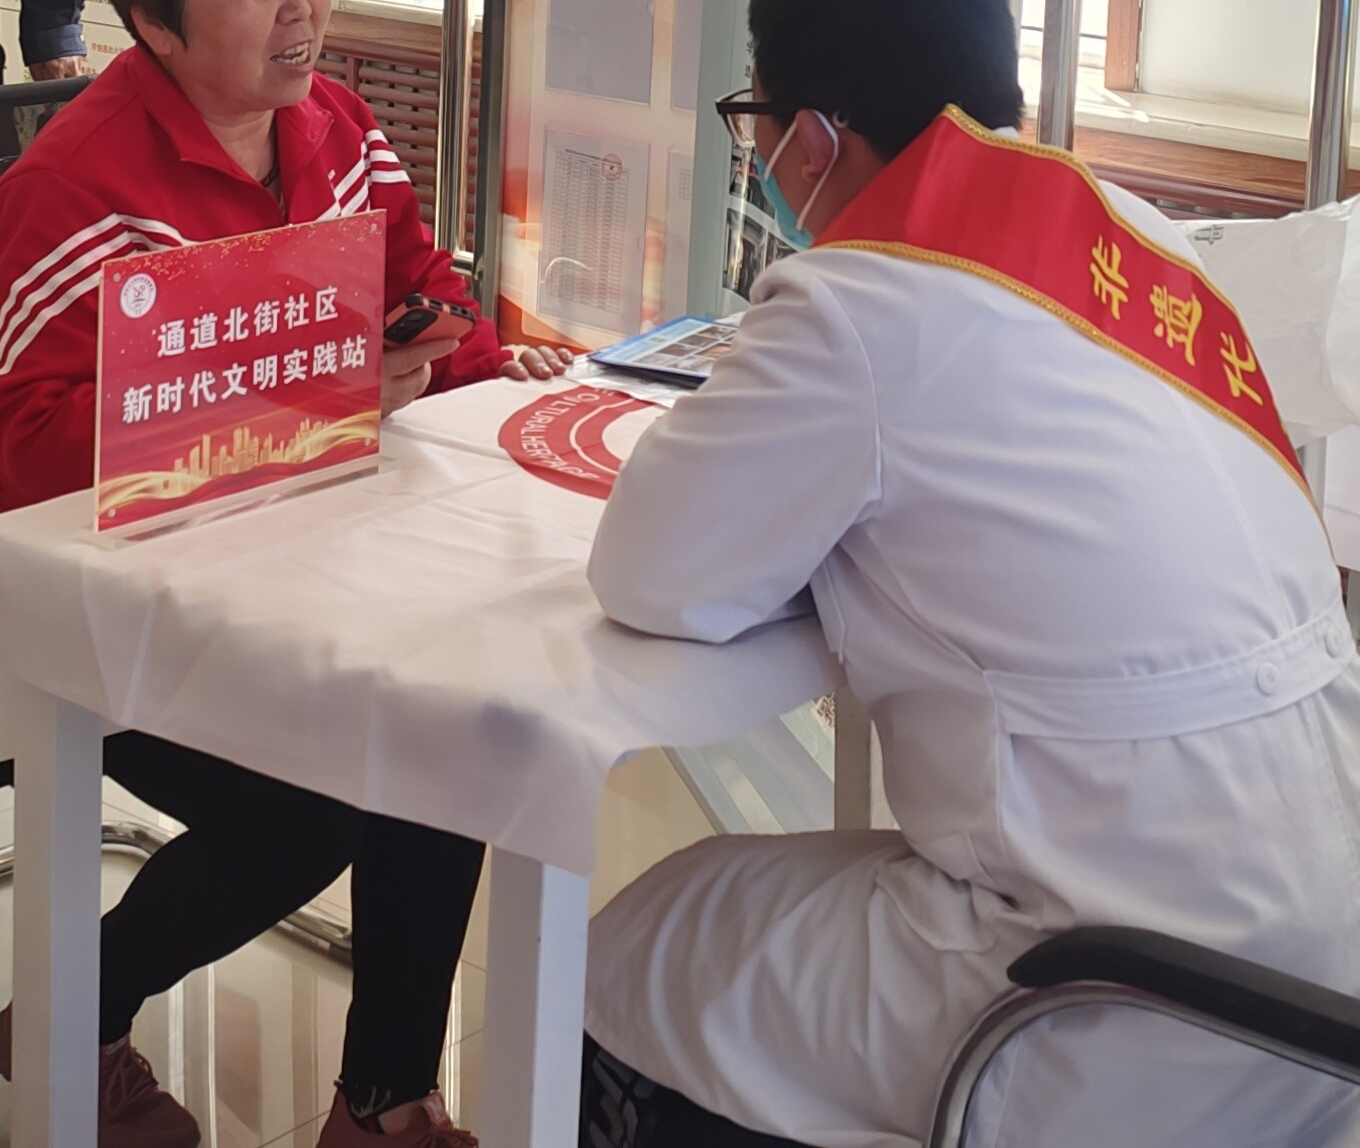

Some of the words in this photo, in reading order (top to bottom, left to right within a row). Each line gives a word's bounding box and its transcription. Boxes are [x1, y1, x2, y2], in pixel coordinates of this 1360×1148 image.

[156, 285, 339, 357] 通道北街社区
[122, 334, 368, 424] 新时代文明实践站
